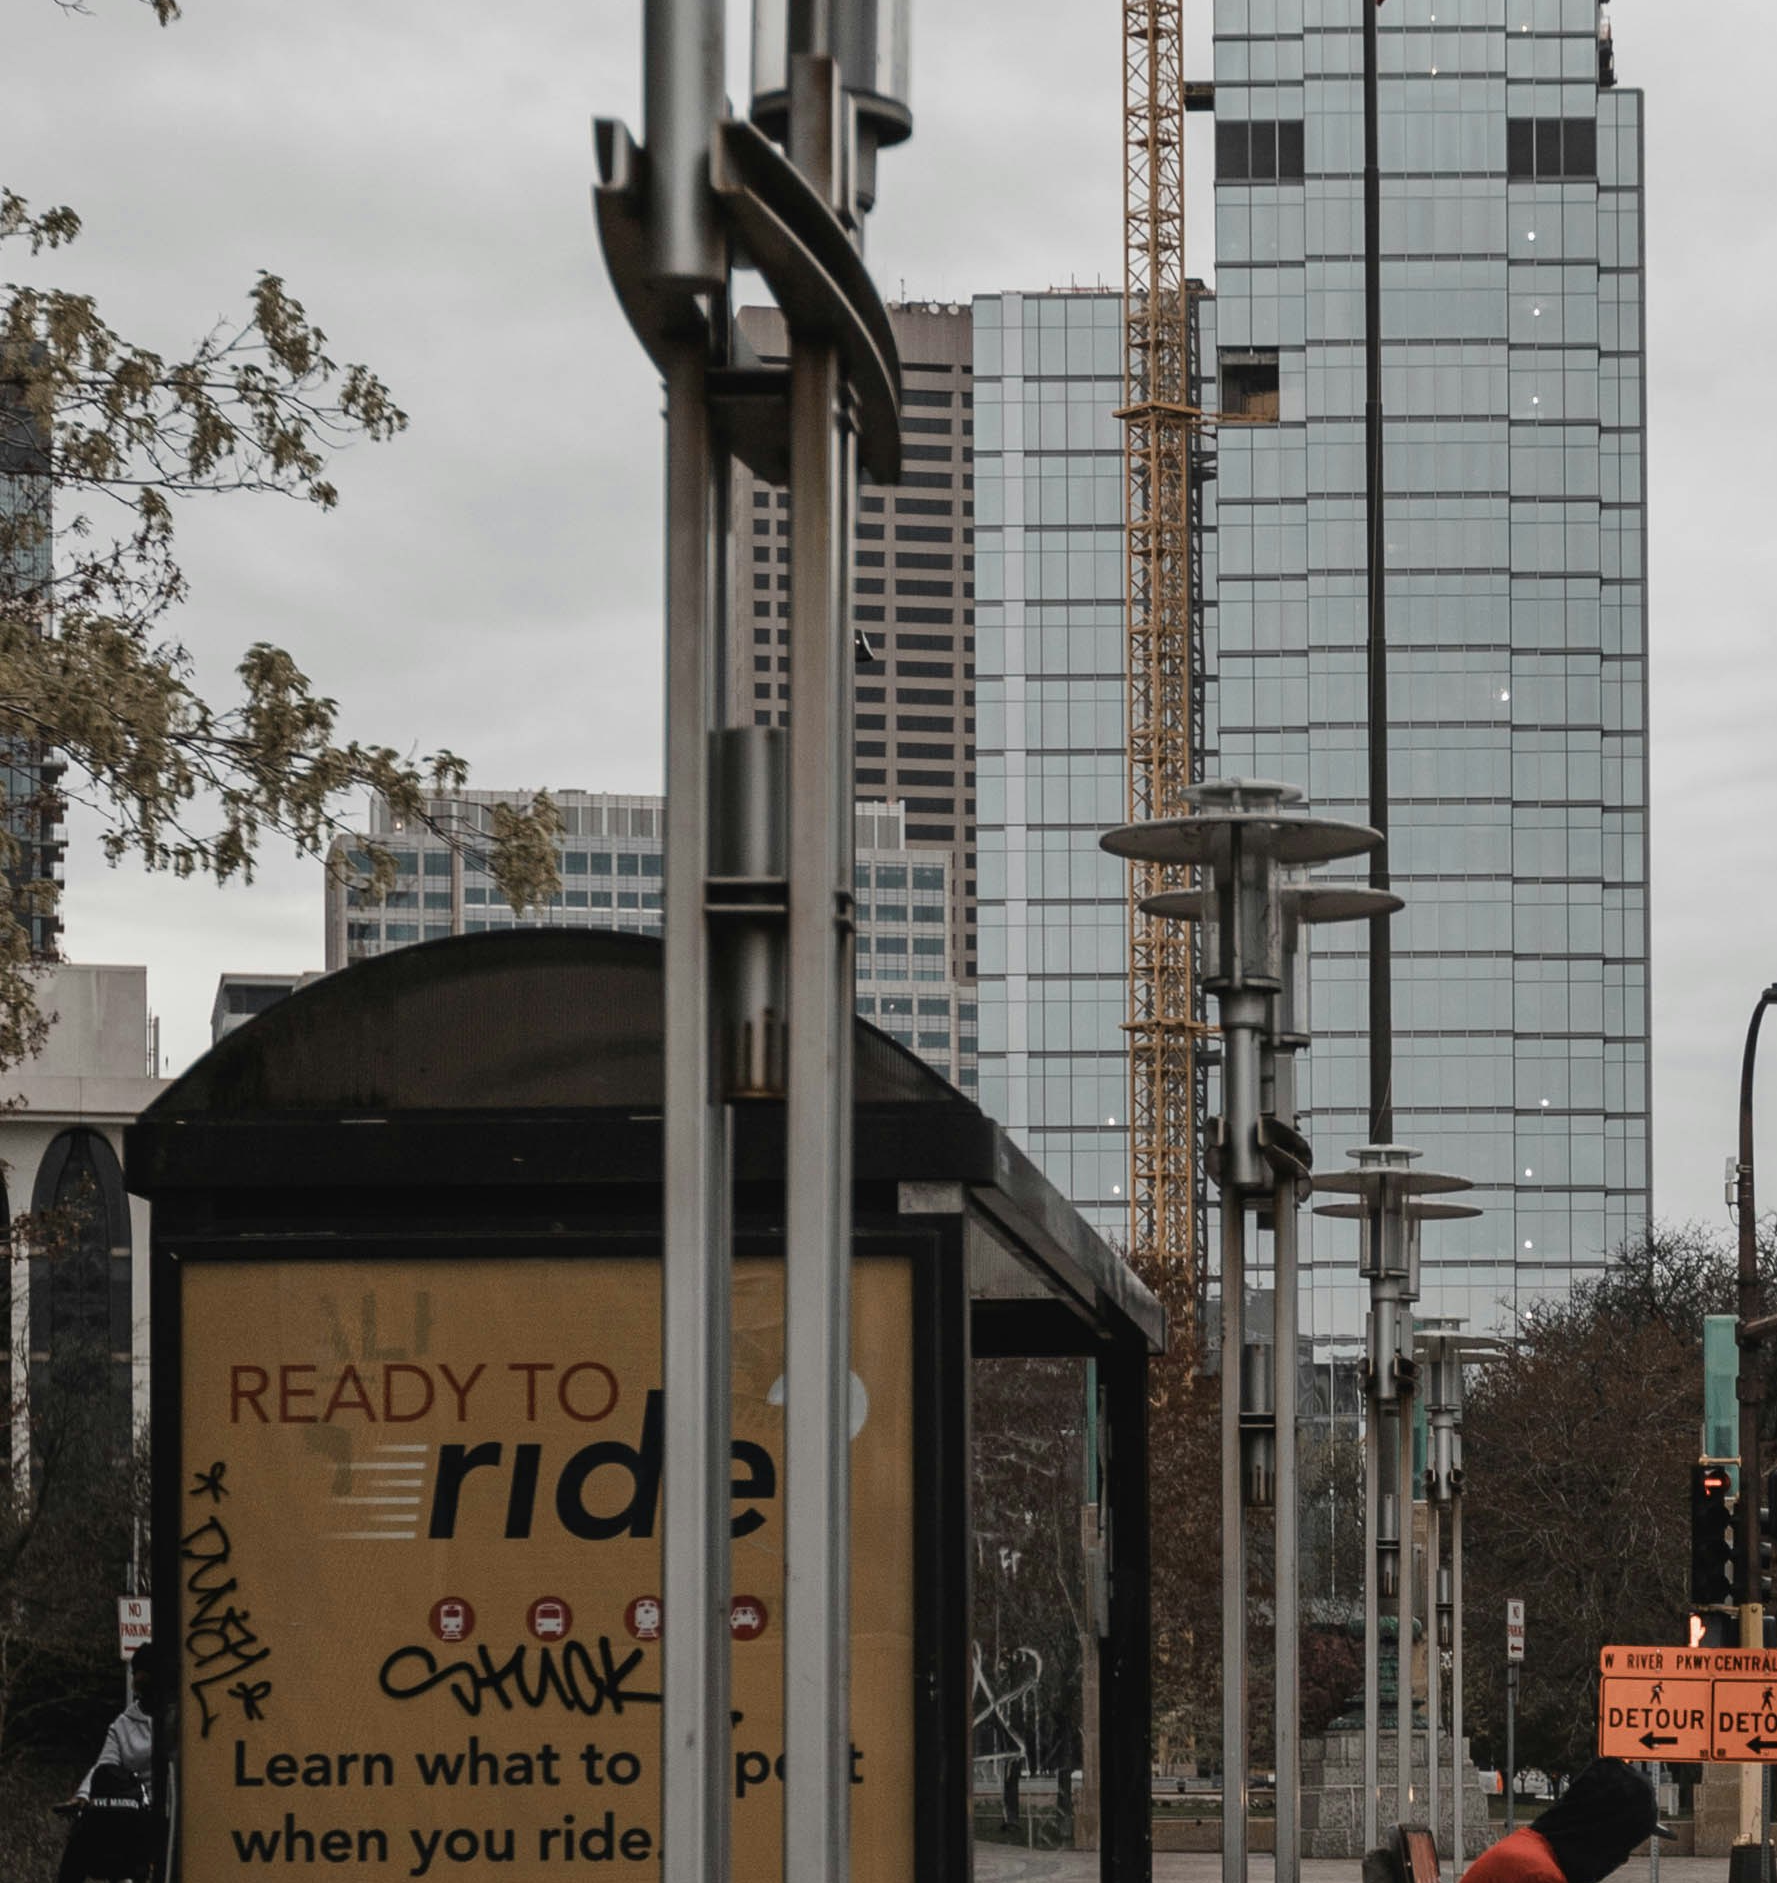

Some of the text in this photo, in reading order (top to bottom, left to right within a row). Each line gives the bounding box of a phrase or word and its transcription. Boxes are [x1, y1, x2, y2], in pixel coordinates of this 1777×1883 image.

[232, 1362, 620, 1424] READY TO
[128, 1601, 142, 1617] NO
[1604, 1654, 1711, 1671] W RIVER PKWY
[1609, 1707, 1704, 1730] DETOUR
[235, 1737, 643, 1789] Learn what to
[231, 1814, 389, 1864] when
[410, 1829, 516, 1879] you
